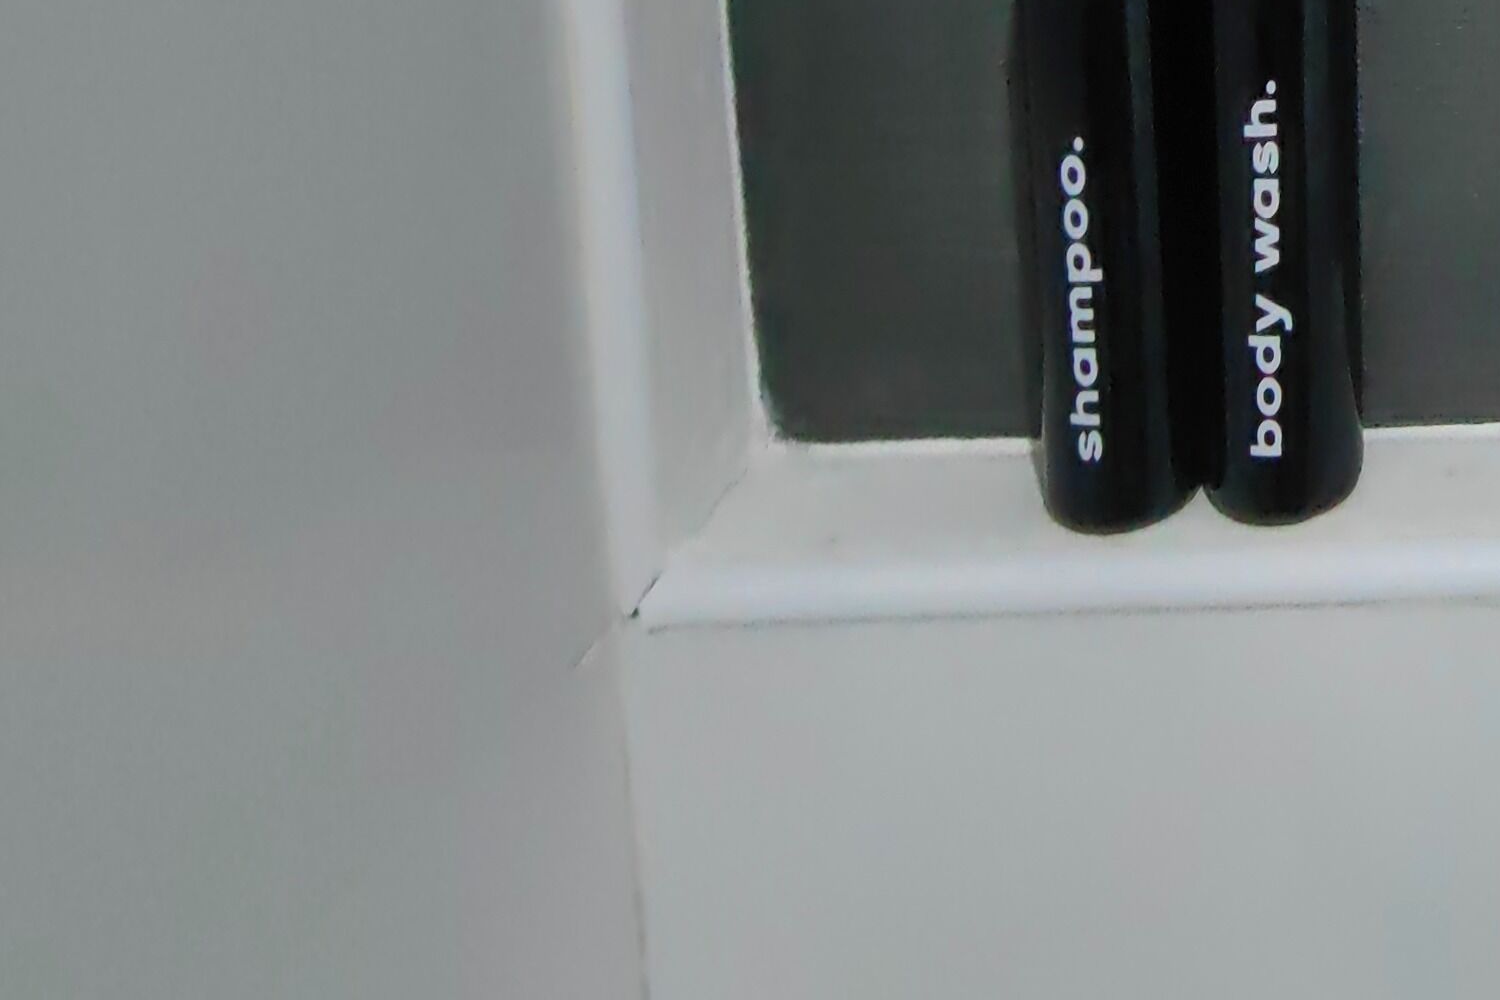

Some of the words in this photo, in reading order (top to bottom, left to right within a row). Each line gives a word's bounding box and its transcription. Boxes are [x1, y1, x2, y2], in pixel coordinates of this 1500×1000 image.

[1243, 80, 1281, 273] wash.
[1060, 136, 1103, 461] shampoo.
[1247, 293, 1293, 457] body
